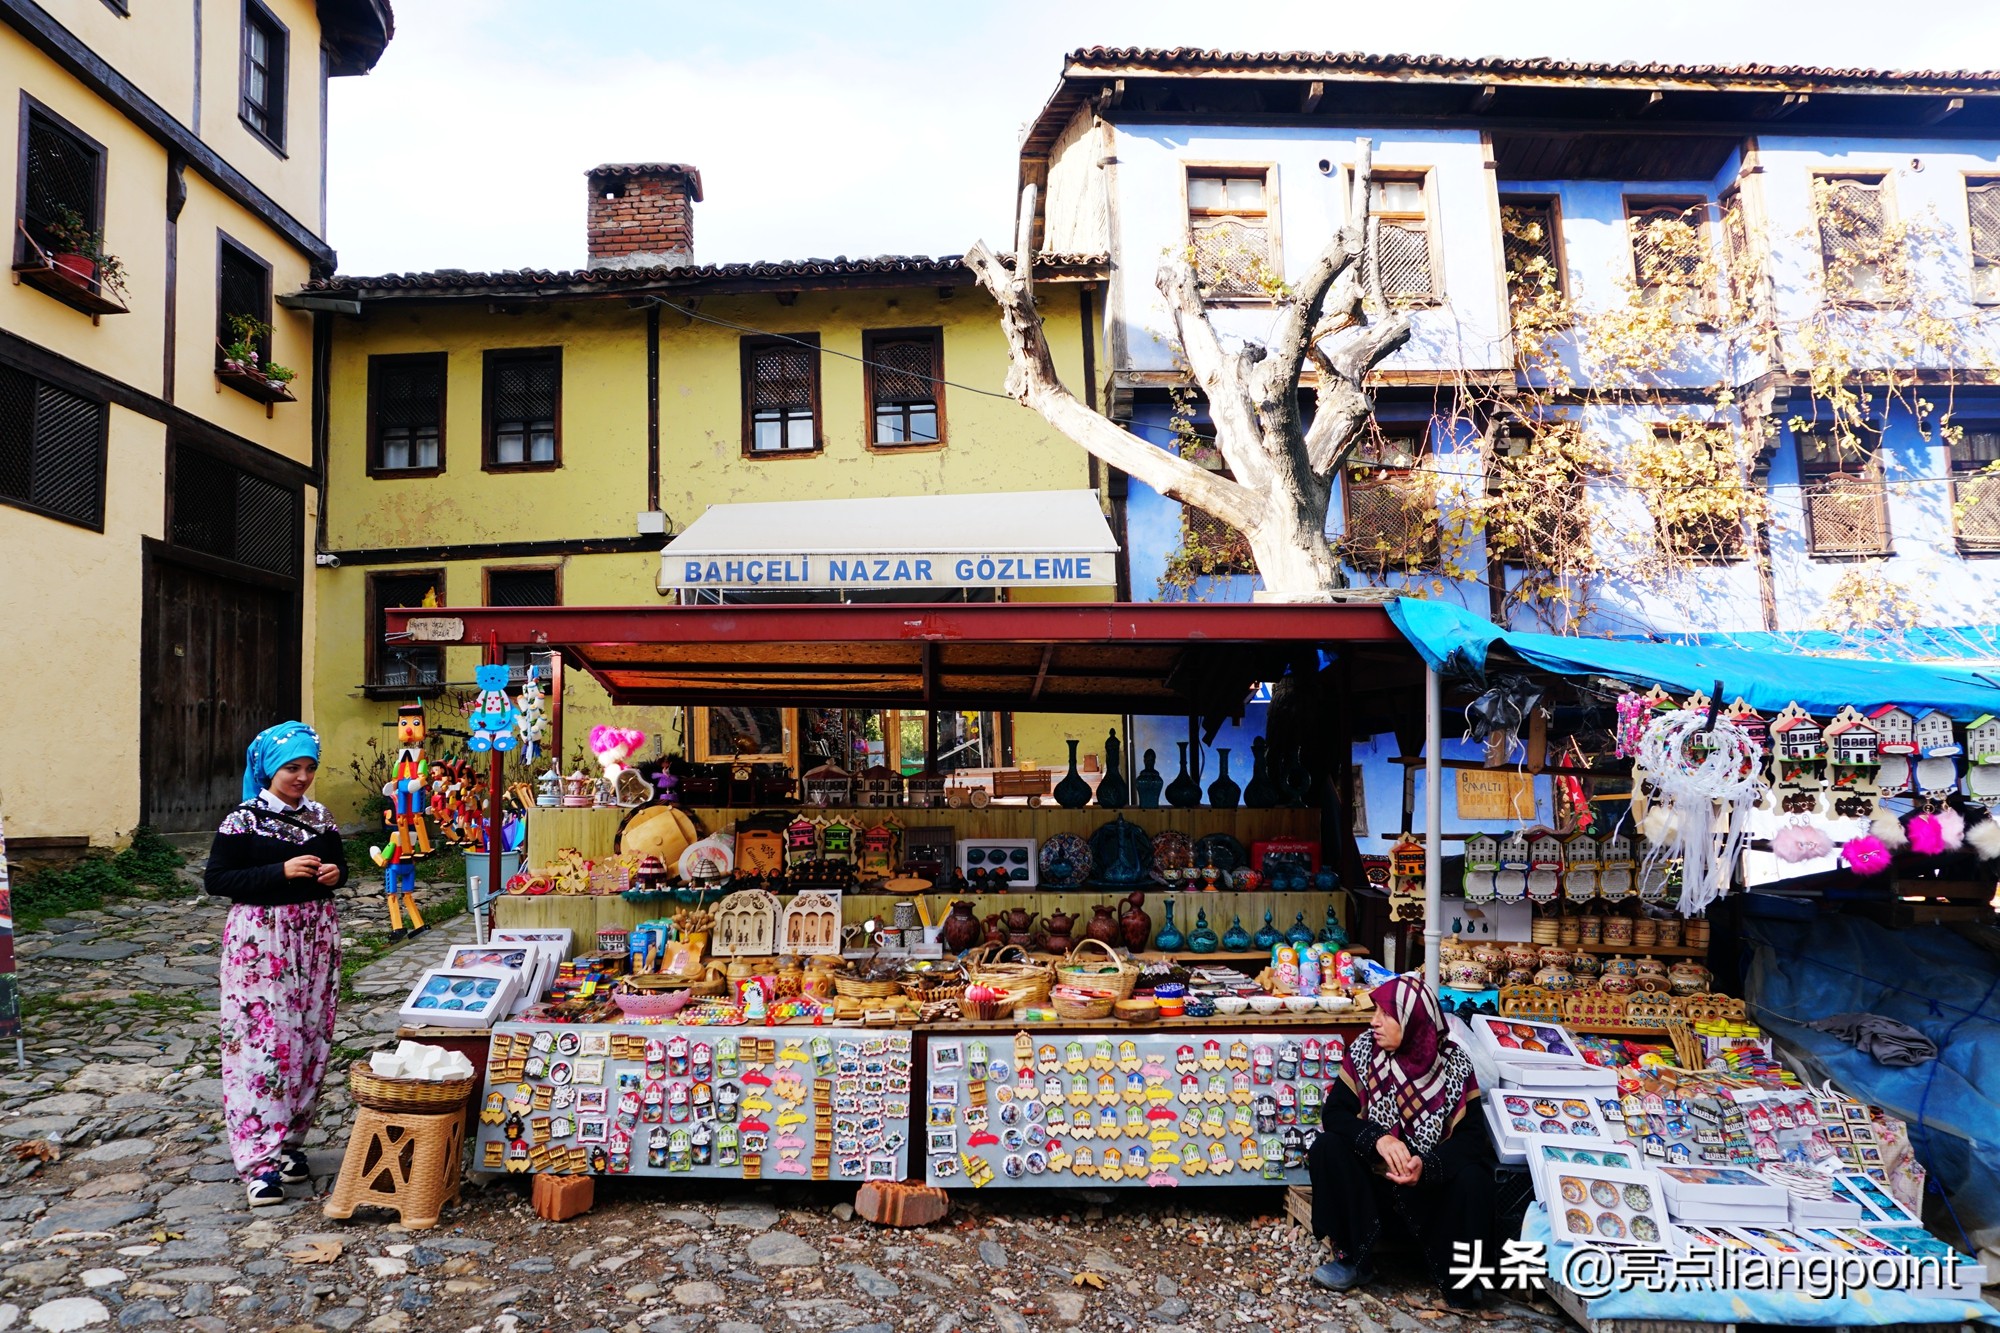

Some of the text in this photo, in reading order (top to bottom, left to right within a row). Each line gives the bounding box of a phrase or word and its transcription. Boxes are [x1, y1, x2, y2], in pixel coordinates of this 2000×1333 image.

[685, 553, 1092, 585] BAHÇELİ NAZAR GÖZLEME
